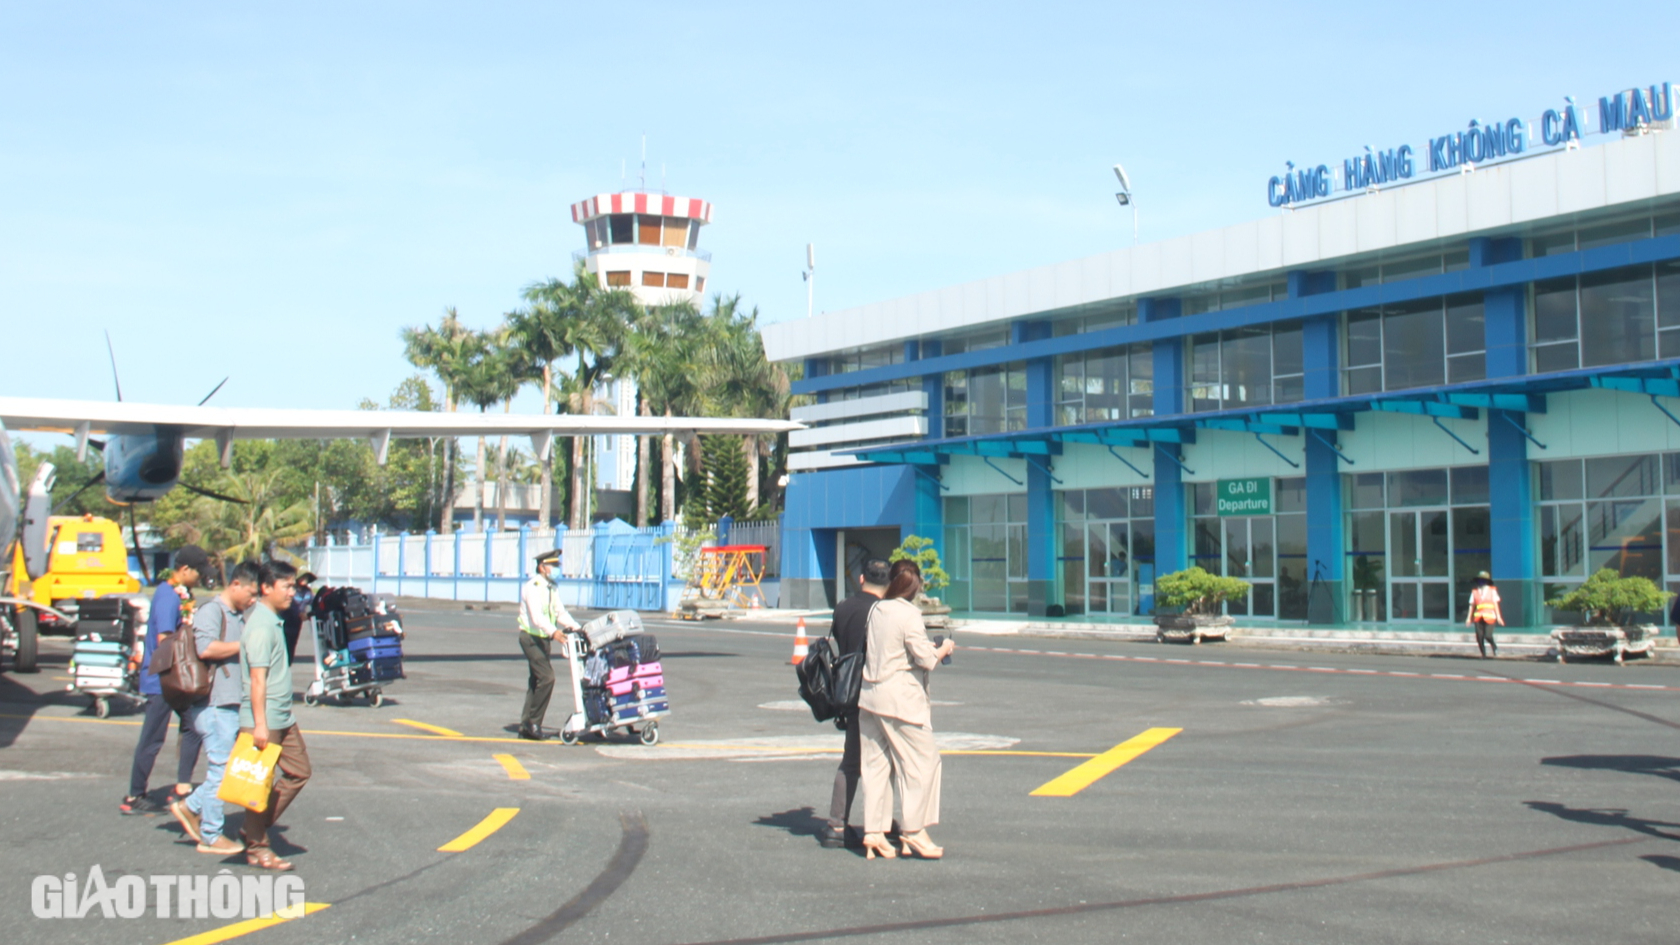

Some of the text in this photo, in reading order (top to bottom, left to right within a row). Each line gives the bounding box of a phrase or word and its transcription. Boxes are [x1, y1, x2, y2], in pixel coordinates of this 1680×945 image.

[1268, 82, 1672, 207] CẢNG HÀNG KHÔNG CÀ MAU
[1228, 481, 1257, 494] GA ĐI
[1219, 499, 1268, 512] Departure
